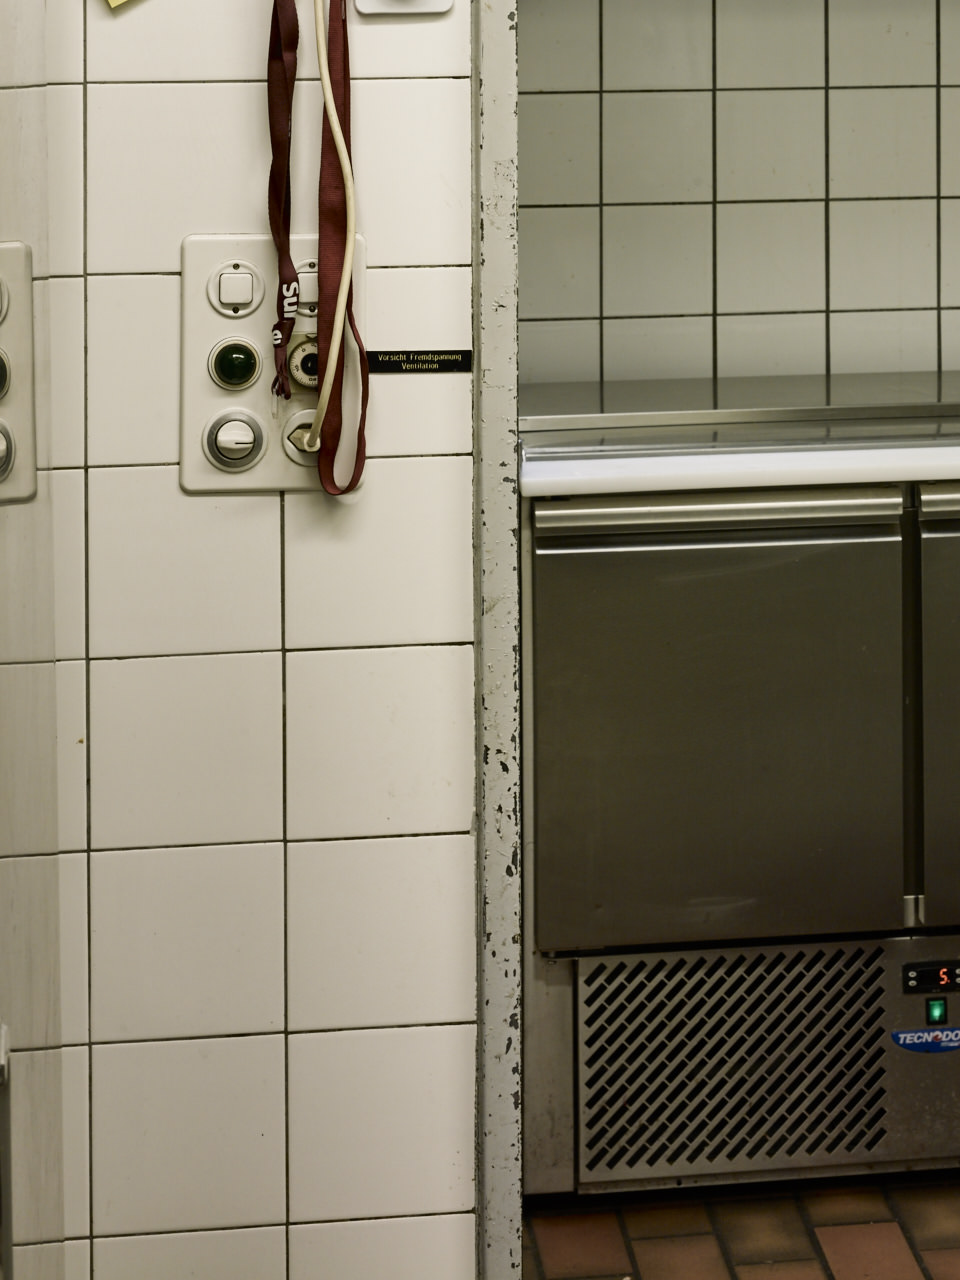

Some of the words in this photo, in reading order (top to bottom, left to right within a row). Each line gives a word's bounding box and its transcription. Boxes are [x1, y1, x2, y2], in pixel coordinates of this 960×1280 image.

[378, 353, 407, 361] Vorsicht
[410, 352, 462, 362] Fremdspannung
[401, 362, 439, 370] Ventilation
